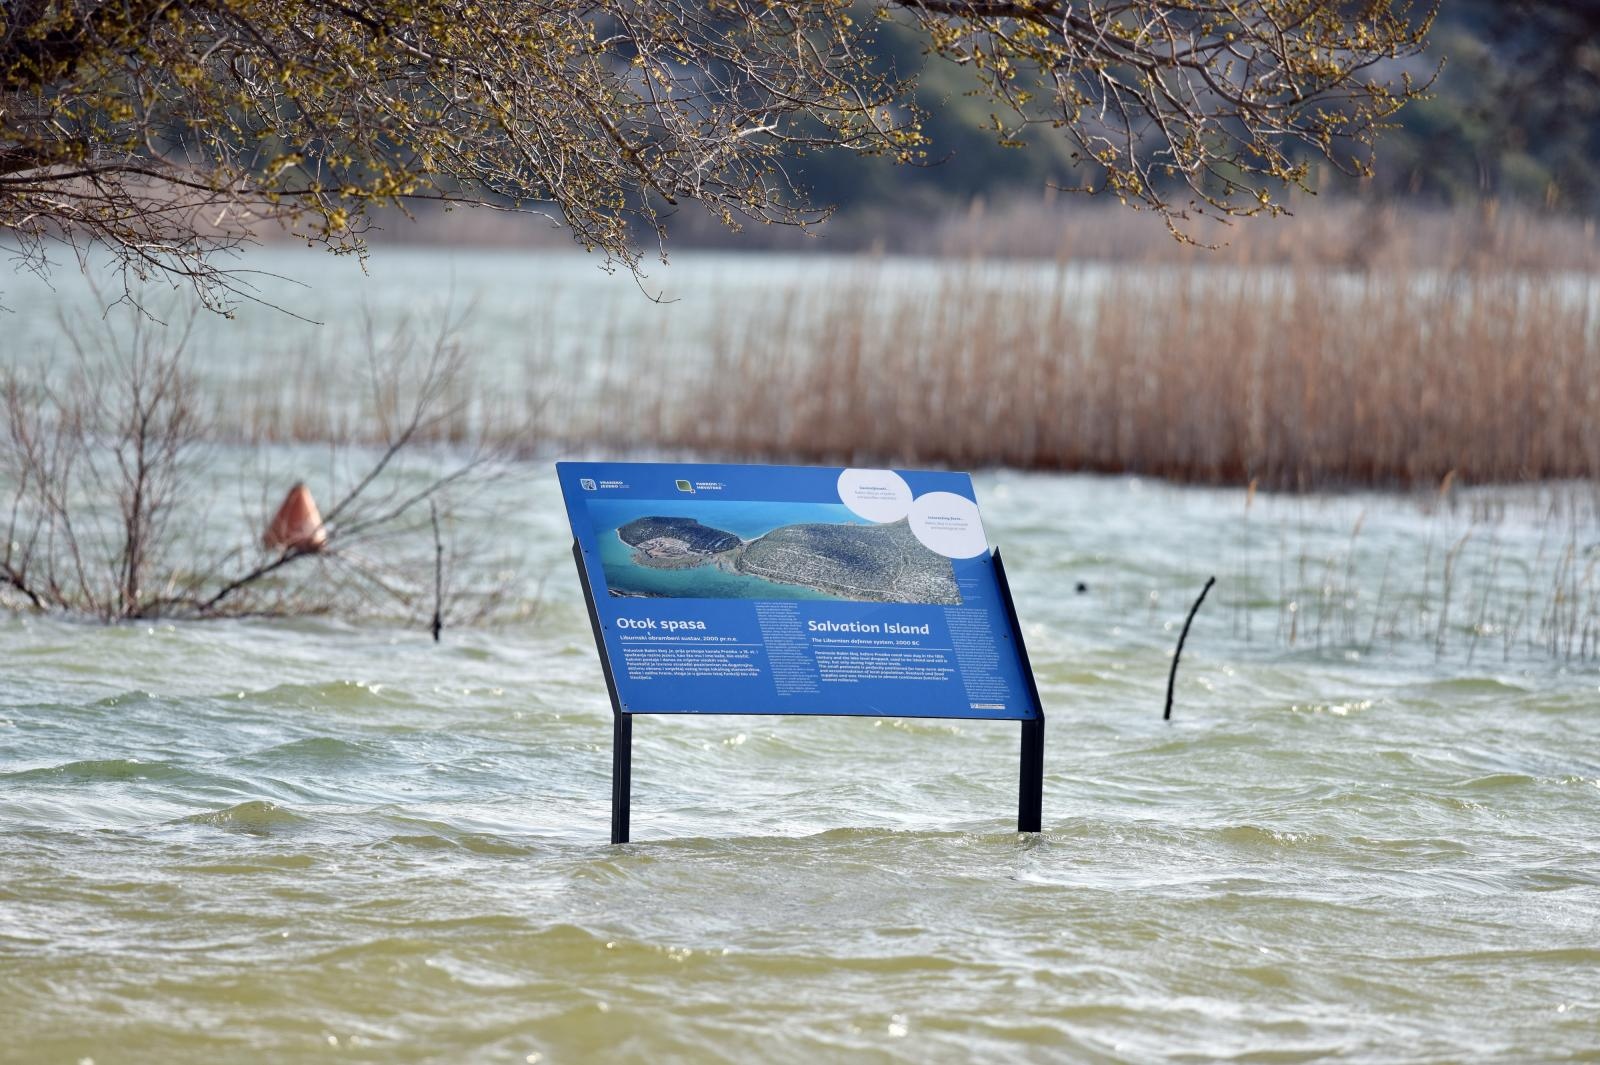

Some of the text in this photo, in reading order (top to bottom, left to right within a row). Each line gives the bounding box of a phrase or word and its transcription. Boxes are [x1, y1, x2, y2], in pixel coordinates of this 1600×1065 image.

[616, 617, 707, 632] Otok spasa
[808, 620, 880, 633] Salvation
[884, 622, 930, 635] Island
